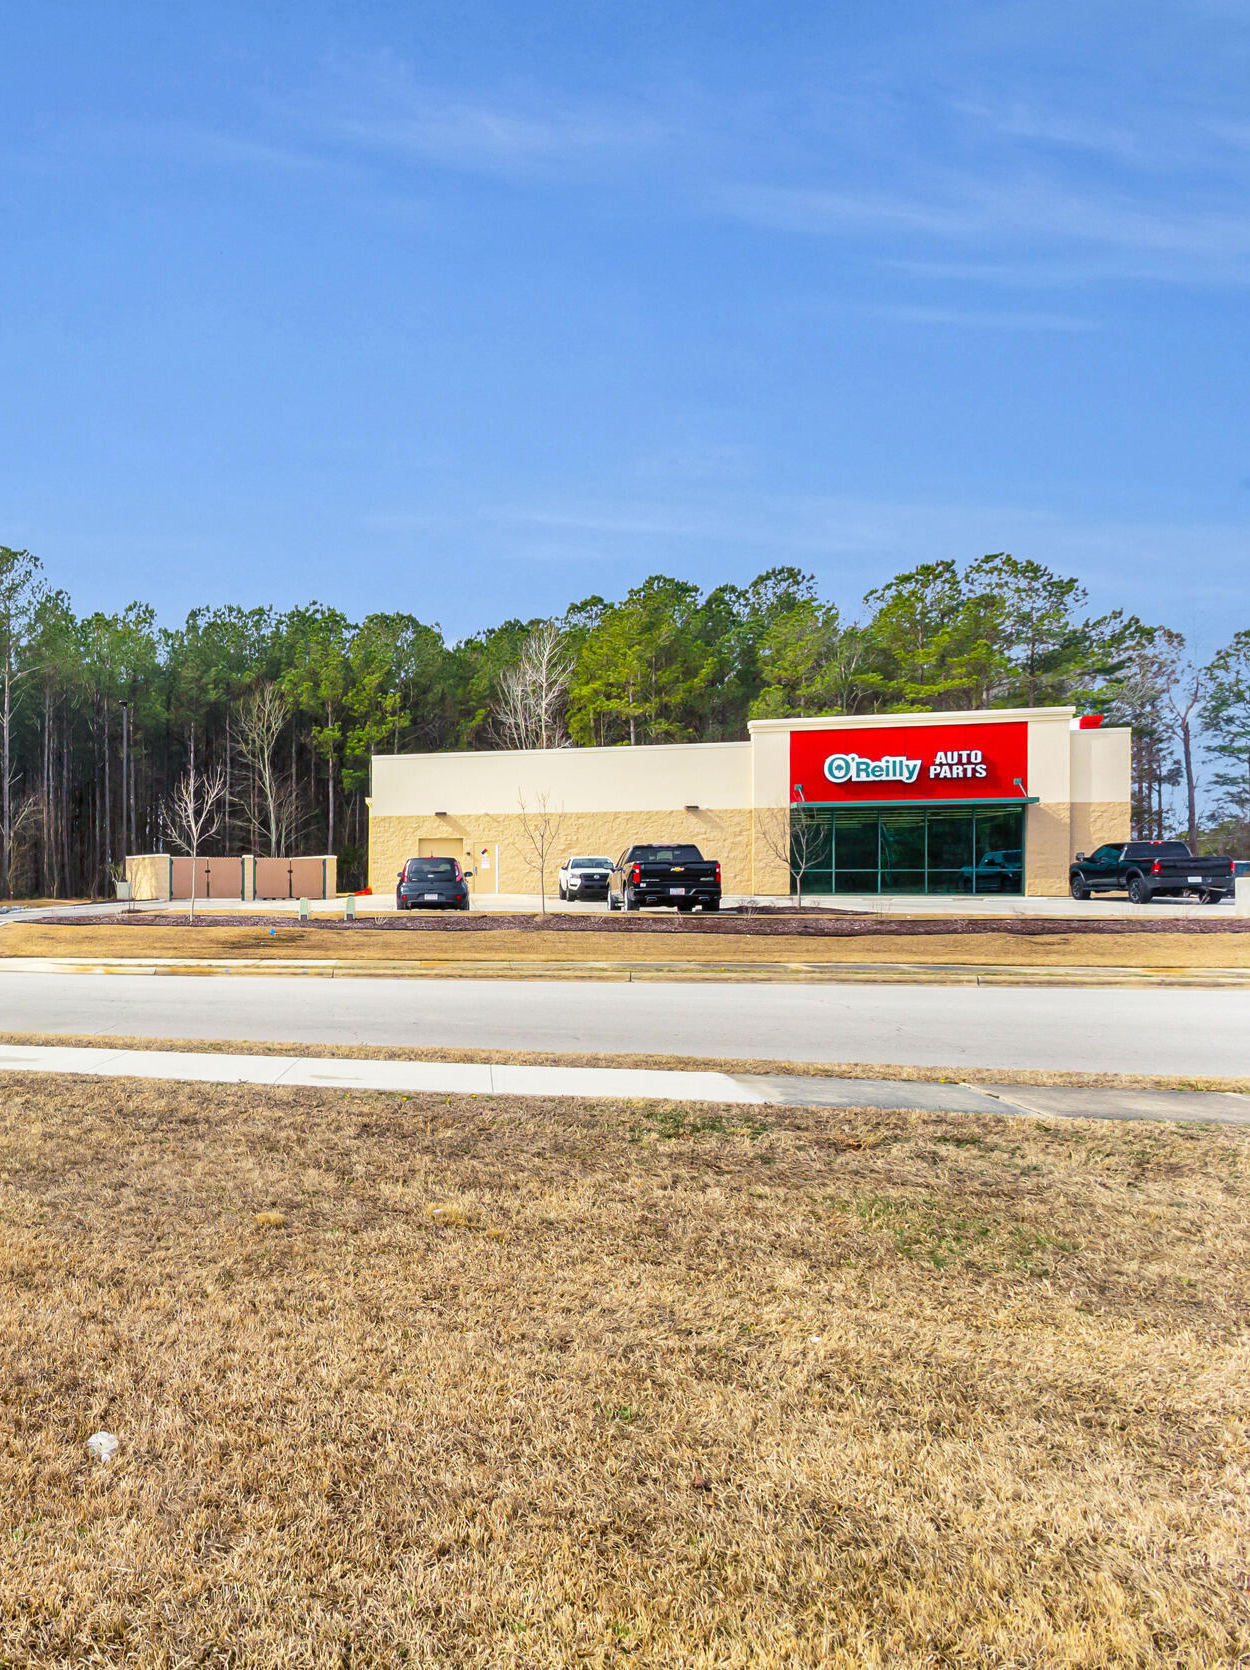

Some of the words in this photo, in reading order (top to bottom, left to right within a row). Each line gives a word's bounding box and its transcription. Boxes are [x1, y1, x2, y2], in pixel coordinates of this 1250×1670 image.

[934, 750, 982, 764] AUTO
[826, 755, 919, 781] O'Reilly
[929, 764, 987, 778] PARTS
